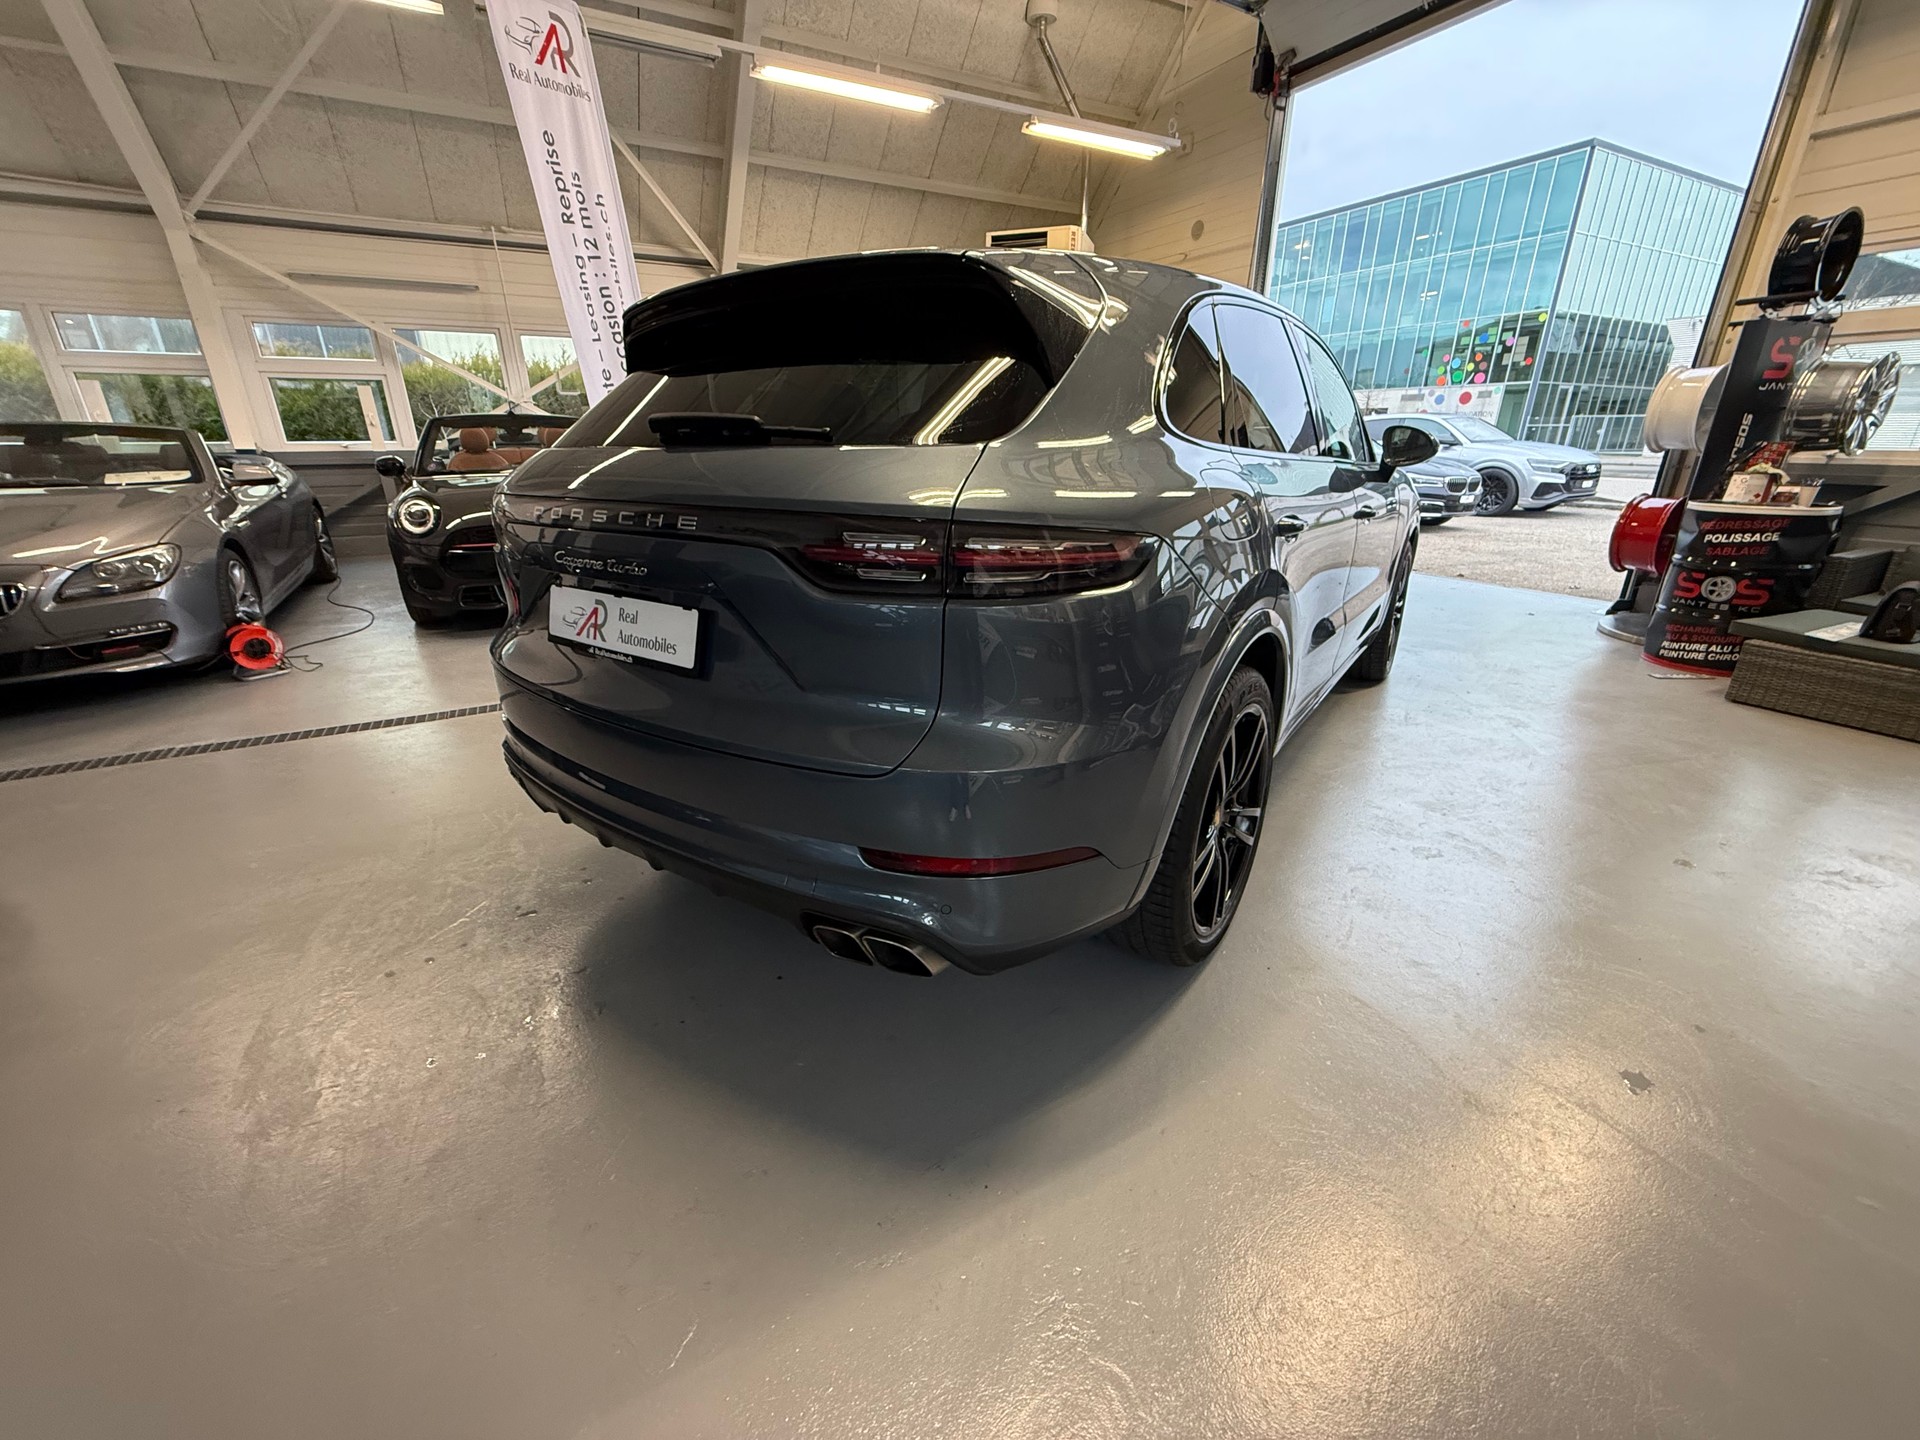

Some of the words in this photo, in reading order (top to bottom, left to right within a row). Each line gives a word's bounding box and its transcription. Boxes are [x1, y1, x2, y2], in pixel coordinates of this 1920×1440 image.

[508, 62, 532, 84] Real
[534, 71, 591, 103] Automobiles
[542, 129, 576, 225] Reprise
[571, 171, 593, 229] mois
[583, 237, 601, 264] 12
[574, 255, 602, 343] Leasing
[532, 505, 698, 531] PORSCHE
[1703, 532, 1781, 544] POLISSAGE
[554, 550, 605, 573] Cayenne
[1705, 546, 1772, 556] SABLAGE
[618, 607, 638, 625] Real
[1671, 597, 1730, 611] JANTES
[617, 628, 678, 656] Automobiles
[1660, 640, 1708, 652] PEINTURE
[1708, 643, 1732, 653] ALU
[1658, 648, 1706, 660] PEINTURE
[1707, 652, 1740, 661] CHRO
